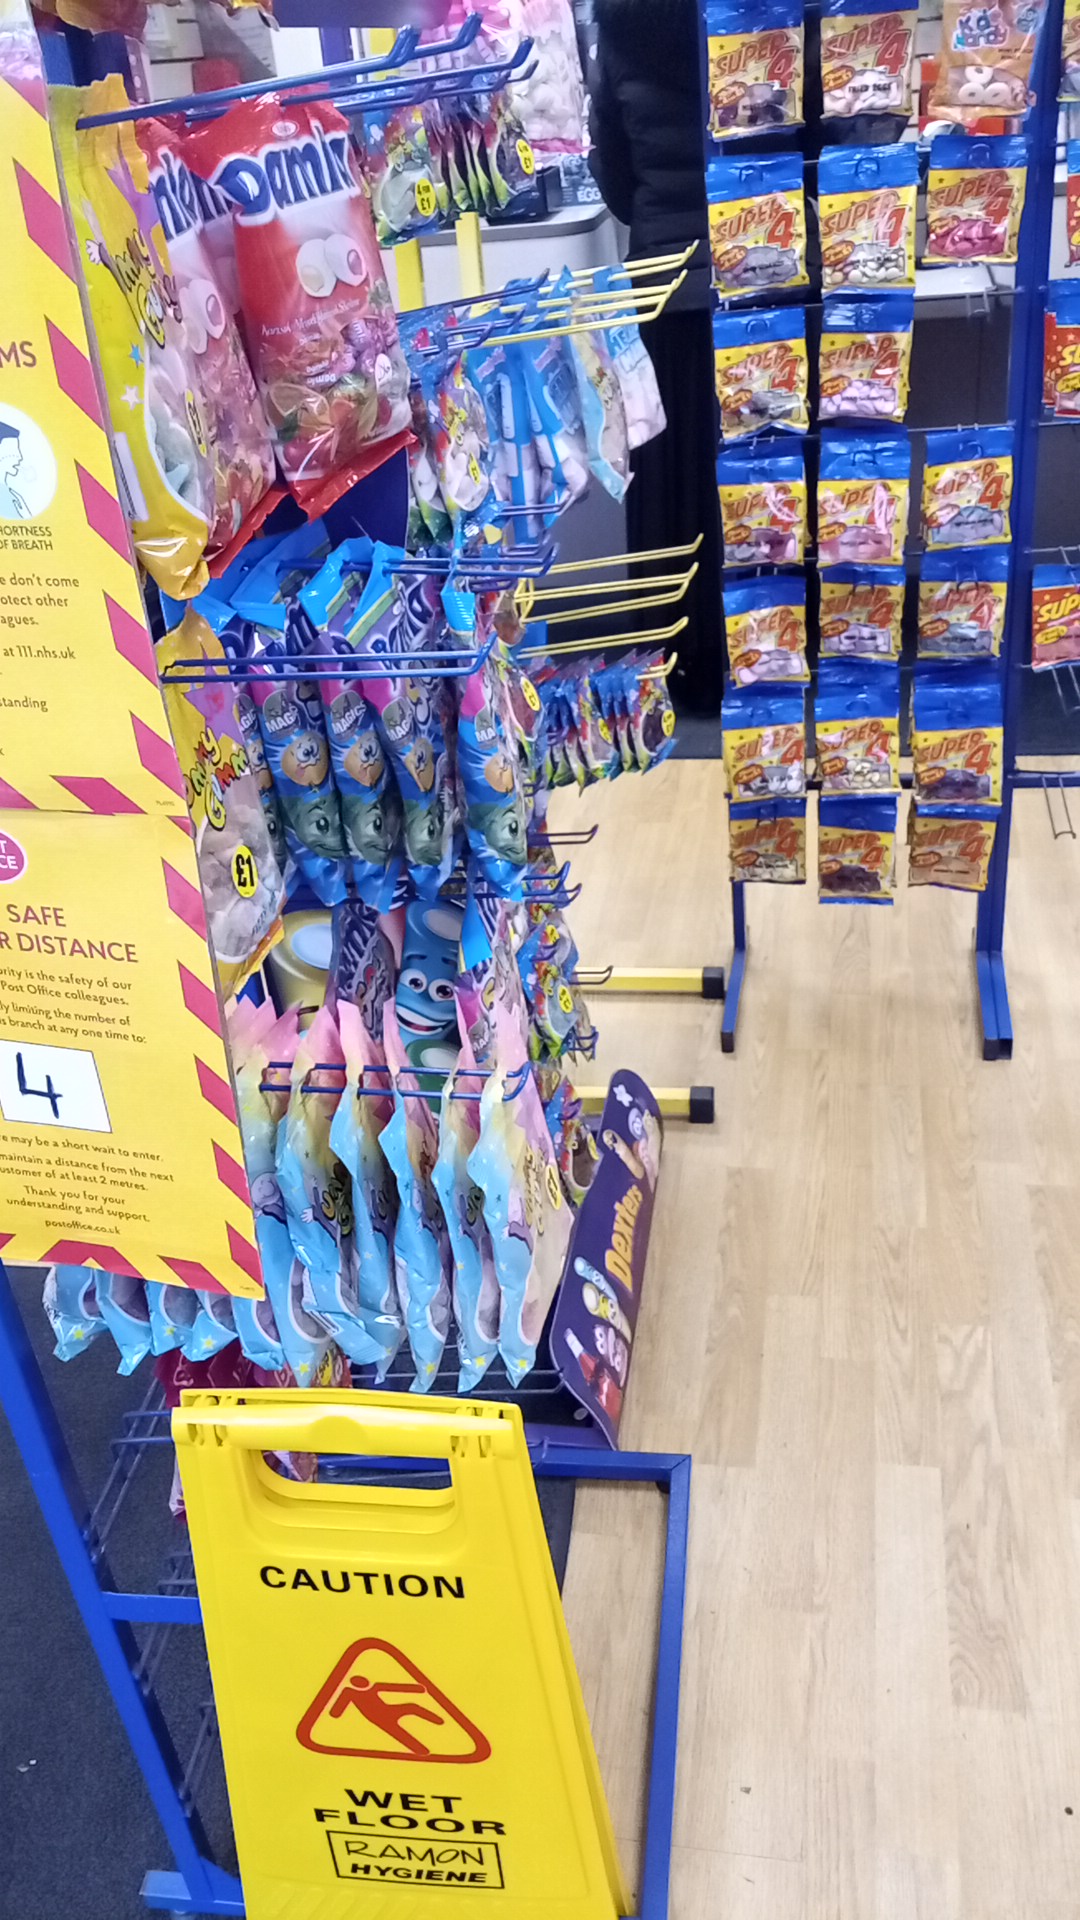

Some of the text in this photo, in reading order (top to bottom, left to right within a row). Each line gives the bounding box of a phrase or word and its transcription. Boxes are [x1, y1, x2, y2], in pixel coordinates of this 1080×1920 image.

[821, 13, 904, 63] SUPER
[872, 29, 911, 77] 4
[714, 30, 789, 79] SUPER
[764, 46, 798, 89] 4
[928, 170, 1009, 212] SUPER
[984, 184, 1015, 226] 4
[713, 193, 787, 245] SUPER
[764, 208, 797, 251] 4
[820, 190, 901, 239] SUPER
[820, 334, 897, 372] SUPER
[869, 348, 905, 388] 4
[769, 355, 800, 396] 4
[977, 472, 1010, 511] 4
[768, 496, 802, 535] 4
[12, 540, 53, 550] BREATH
[10, 572, 42, 586] don't
[45, 578, 80, 587] come
[36, 593, 68, 607] other
[865, 599, 899, 630] 4
[968, 595, 1001, 630] 4
[776, 619, 803, 653] 4
[3, 645, 76, 659] at 111.nhs.uk
[779, 738, 805, 766] 4
[864, 731, 893, 764] 4
[915, 730, 987, 763] SUPER
[963, 741, 993, 776] 4
[774, 829, 802, 859] 4
[859, 844, 888, 871] 4
[958, 833, 988, 863] 4
[236, 854, 255, 888] £1
[6, 903, 67, 927] SAFE
[17, 933, 139, 963] DISTANCE
[1, 981, 129, 1005] Post Office colleagues.
[25, 970, 34, 979] is
[37, 970, 55, 982] the
[58, 973, 93, 989] safety
[97, 976, 108, 988] of
[112, 981, 132, 990] our
[11, 1002, 52, 1019] limiting
[53, 1008, 71, 1019] the
[74, 1012, 116, 1025] number
[119, 1016, 130, 1026] of
[9, 1016, 45, 1030] branch
[48, 1022, 58, 1032] at
[60, 1026, 79, 1037] any
[82, 1029, 102, 1038] one
[105, 1030, 130, 1041] time
[131, 1034, 147, 1044] to:
[16, 1052, 63, 1119] 4
[11, 1136, 33, 1148] may
[35, 1136, 50, 1147] be
[52, 1140, 59, 1148] a
[62, 1139, 90, 1151] short
[92, 1145, 116, 1155] wait
[117, 1149, 130, 1157] to
[132, 1151, 164, 1162] enter.
[0, 1153, 174, 1183] maintain a distance from the next
[45, 1169, 56, 1179] of
[59, 1171, 70, 1180] at
[71, 1171, 98, 1184] least
[100, 1175, 108, 1184] 2
[109, 1179, 149, 1191] metres.
[6, 1197, 151, 1222] understanding and support.
[24, 1185, 125, 1205] Thank you for your
[45, 1220, 121, 1235] postoffice.co.uk
[260, 1565, 465, 1599] CAUTION
[344, 1788, 462, 1813] WET
[314, 1808, 507, 1836] FLOOR
[344, 1840, 485, 1867] RAMON
[350, 1863, 487, 1884] HYGIENE
